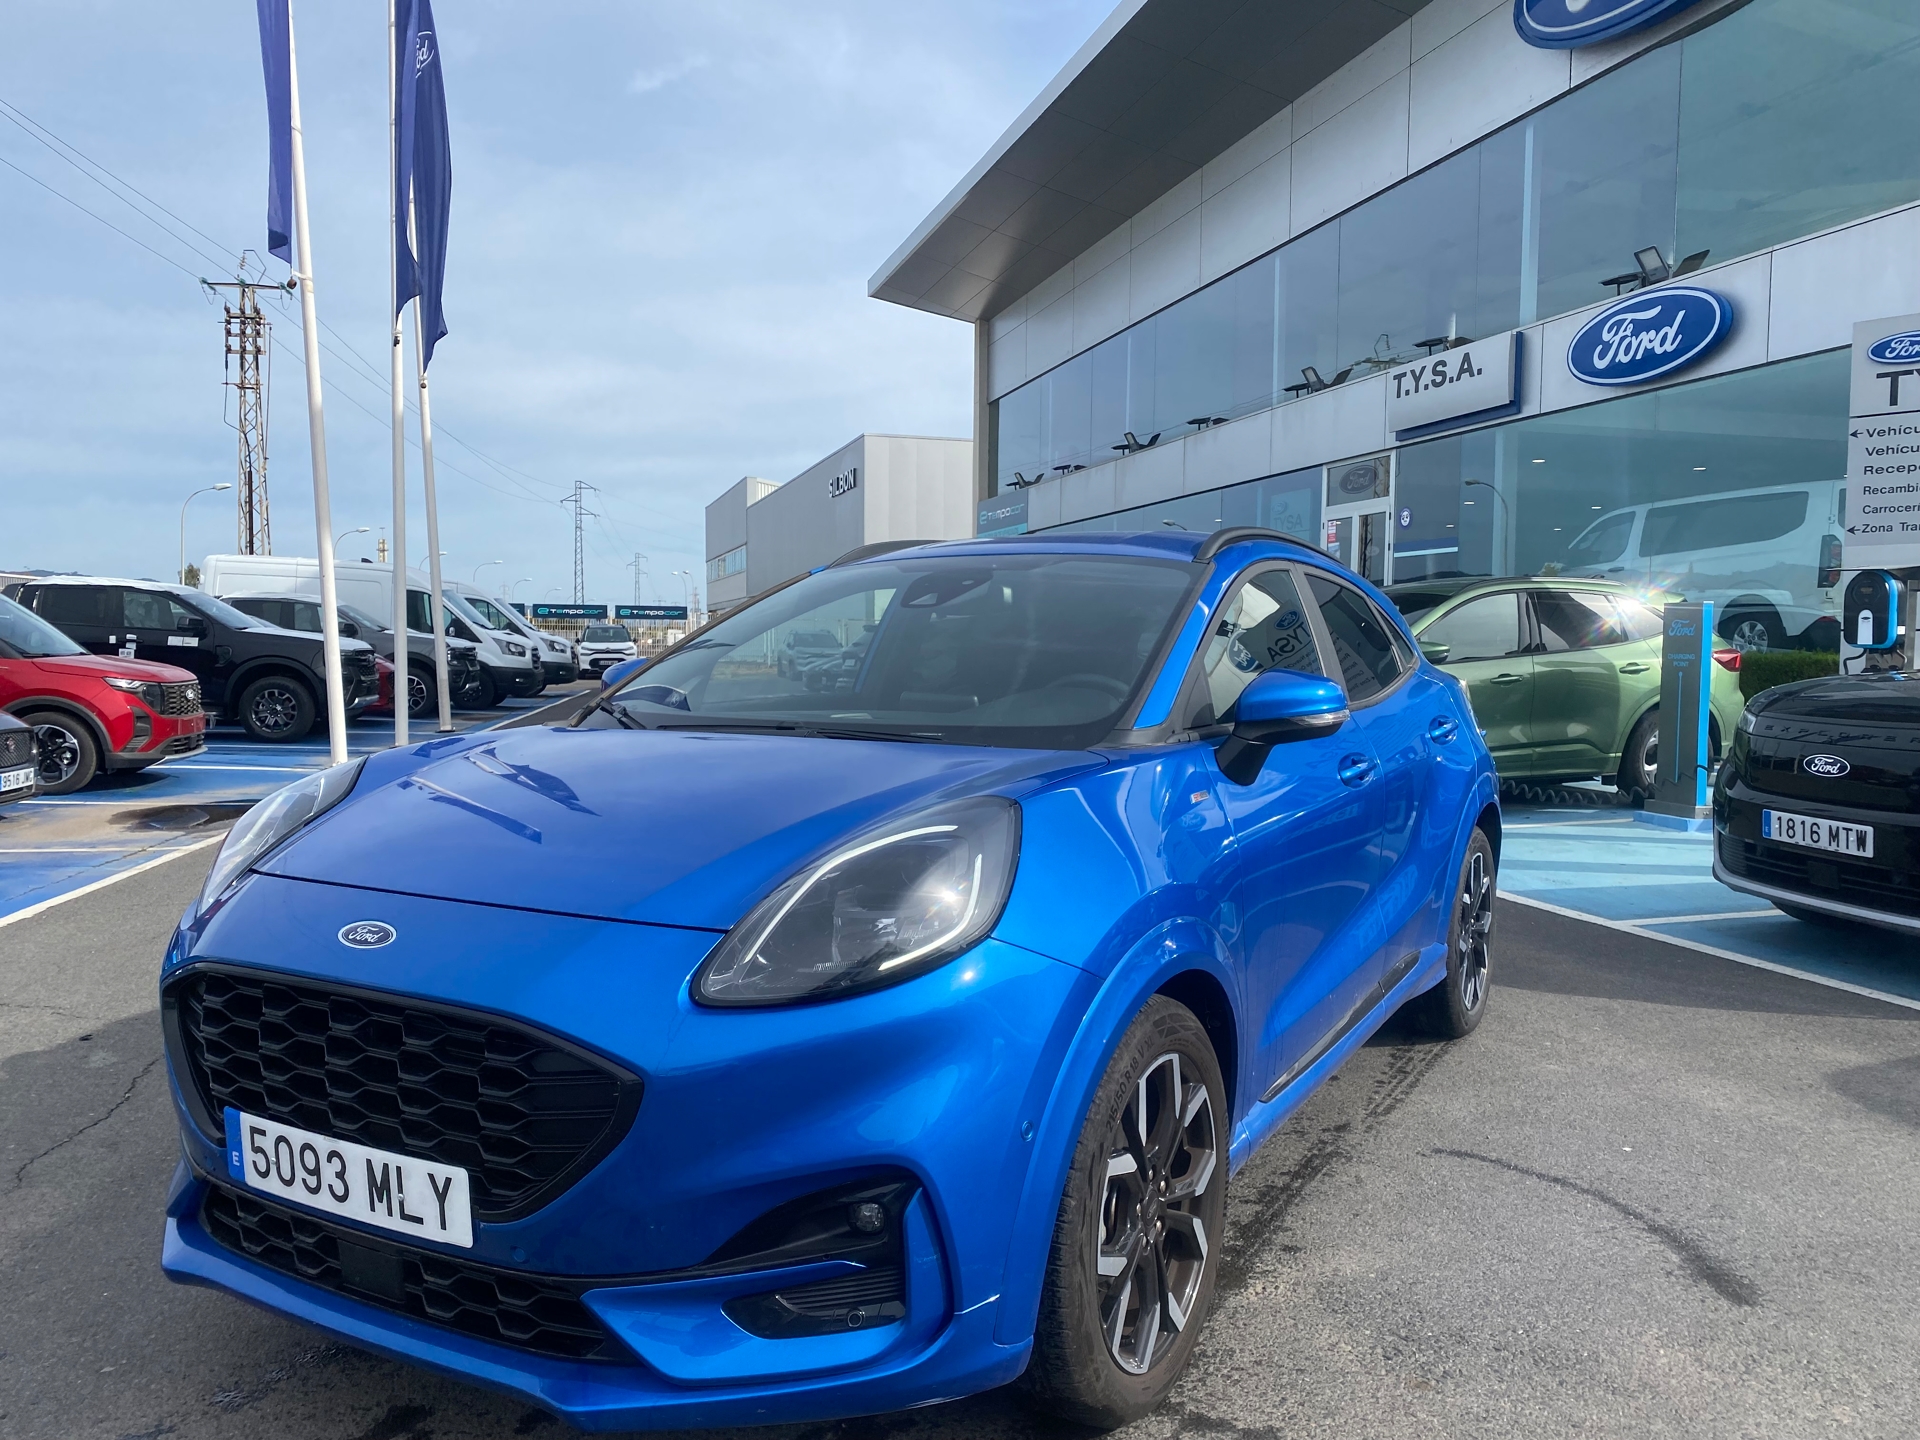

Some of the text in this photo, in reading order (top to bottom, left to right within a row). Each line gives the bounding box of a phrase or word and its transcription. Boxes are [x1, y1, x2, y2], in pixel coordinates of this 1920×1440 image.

[1593, 304, 1687, 370] Ford
[1884, 337, 1920, 358] For
[1392, 352, 1483, 399] T.Y.S.A.
[1876, 368, 1920, 407] T
[1865, 443, 1920, 456] Vehícu
[1347, 469, 1369, 489] Ford
[1863, 464, 1920, 475] Recep
[828, 467, 857, 498] SILBON
[1863, 482, 1920, 495] Recambi
[1273, 513, 1303, 531] TYSA
[1861, 521, 1920, 534] Zona Tra
[1669, 619, 1696, 636] Ford
[1811, 757, 1841, 774] Ford
[1776, 816, 1821, 844] 1816
[1828, 824, 1867, 853] MTW
[348, 926, 384, 942] Ford
[1106, 1082, 1127, 1133] 215/50
[232, 1125, 453, 1231] E 5093 MLY
